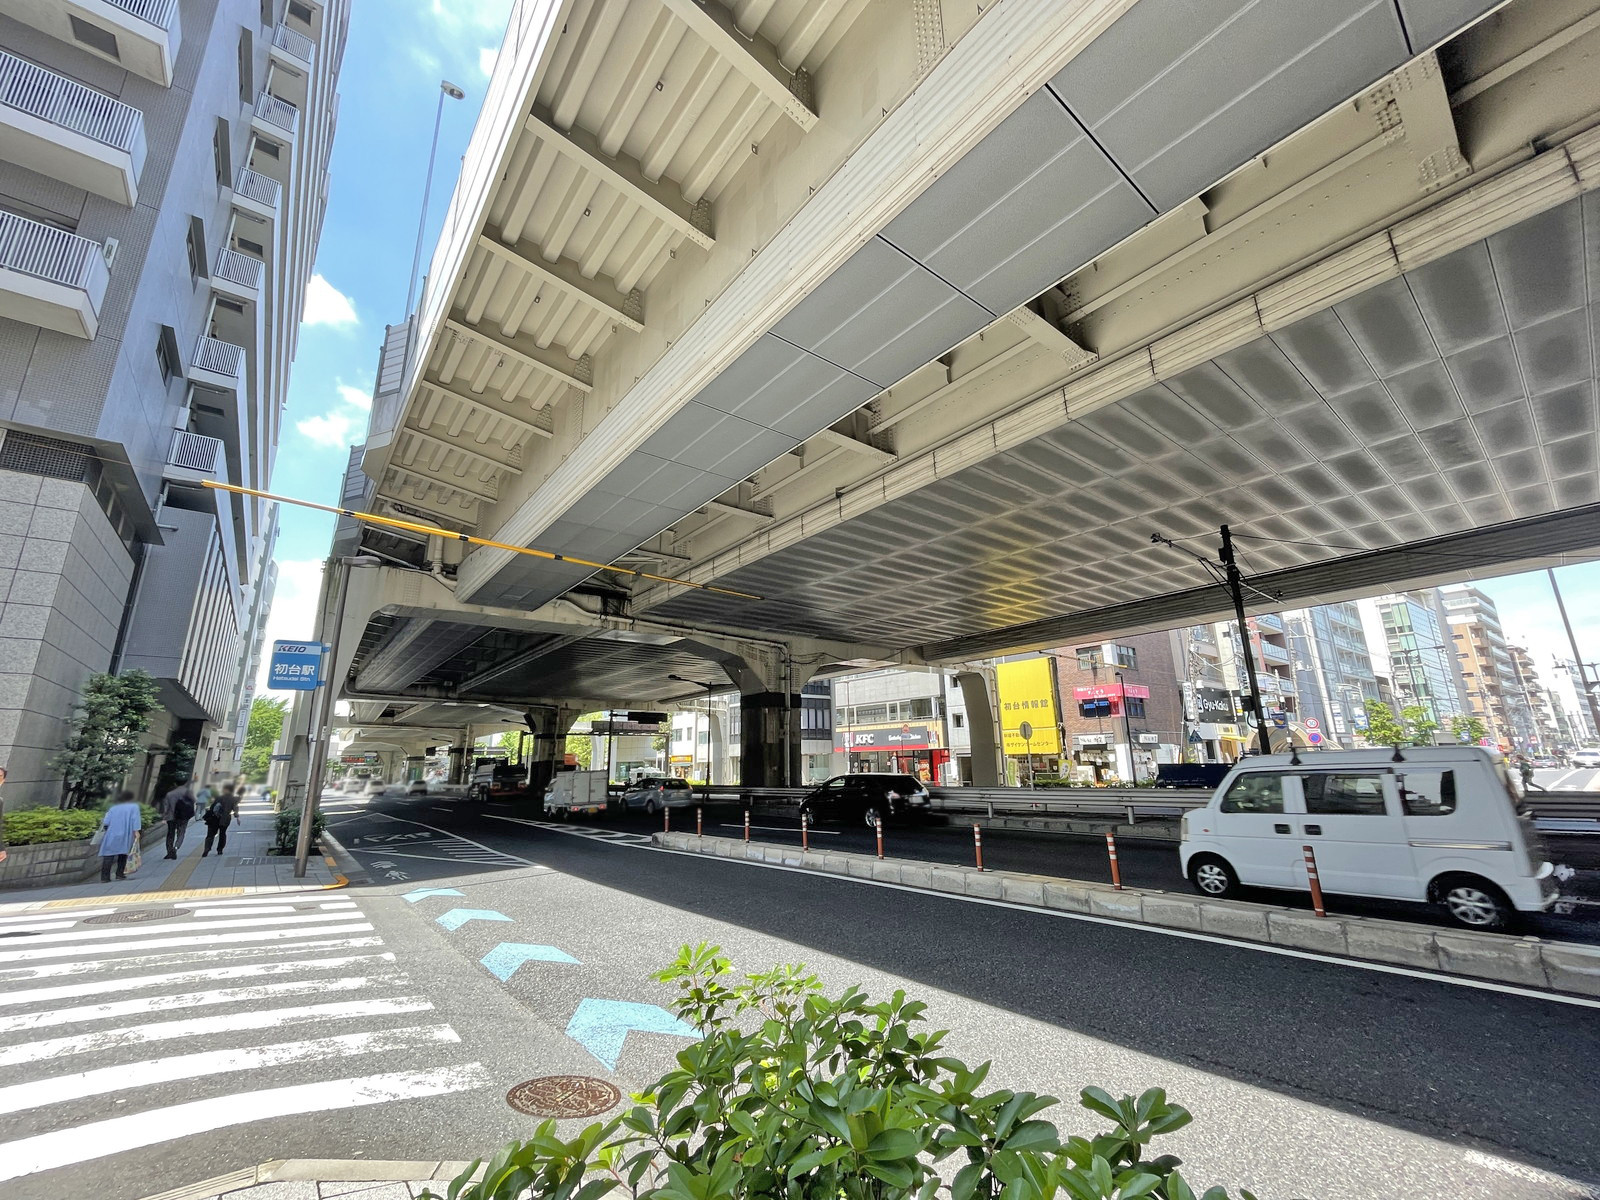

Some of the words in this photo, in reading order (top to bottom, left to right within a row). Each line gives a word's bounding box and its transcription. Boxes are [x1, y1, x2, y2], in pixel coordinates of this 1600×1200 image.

[278, 645, 307, 653] KEIO
[274, 663, 315, 676] 初台駅
[1004, 699, 1049, 711] 初台情報館
[855, 733, 875, 745] KFC
